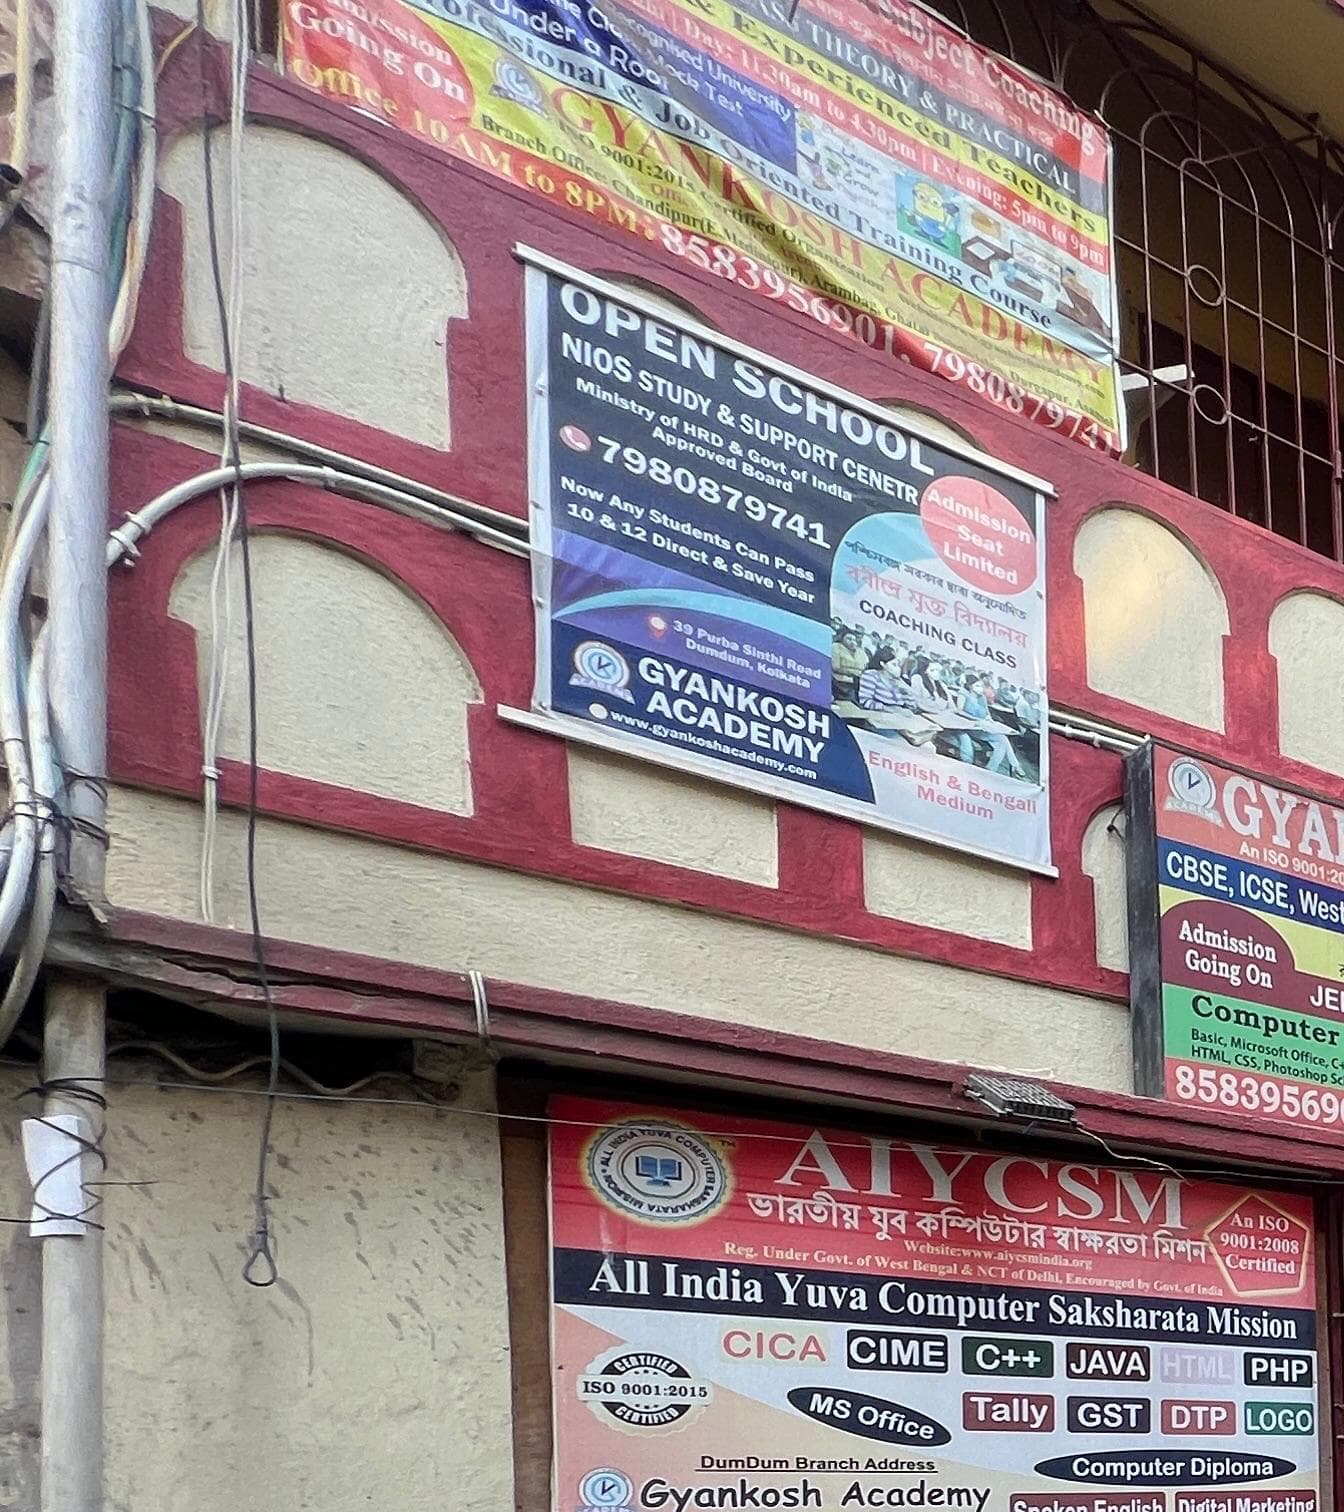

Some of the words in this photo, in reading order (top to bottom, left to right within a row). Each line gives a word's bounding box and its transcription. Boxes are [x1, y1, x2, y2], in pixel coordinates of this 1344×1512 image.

[292, 59, 400, 116] Office
[412, 110, 514, 178] 10AM
[732, 11, 953, 151] Experienced
[960, 138, 1099, 234] Teachers
[808, 20, 917, 98] THEORY
[946, 102, 1079, 194] PRACTICAL
[729, 136, 841, 222] Oriented
[967, 273, 1054, 329] Course
[561, 283, 715, 380] OPEN
[732, 359, 935, 475] SCHOOL
[562, 332, 631, 383] NIOS
[638, 370, 711, 416] STUDY
[717, 404, 735, 427] &
[740, 413, 838, 471] SUPPORT
[842, 458, 919, 506] CENETR
[576, 378, 655, 422] Ministry
[683, 421, 723, 447] HRD
[652, 427, 736, 470] Approved
[742, 464, 793, 493] Board
[597, 436, 831, 549] 7980879741
[649, 510, 730, 549] Students
[928, 489, 1031, 544] Admission
[958, 525, 1005, 556] Seat
[944, 542, 1019, 585] Limited
[860, 600, 956, 645] COACHING
[962, 638, 1017, 669] CLASS
[638, 657, 830, 739] GYANKOSH
[610, 710, 817, 780] www.gyankoshacademy.com
[647, 691, 825, 763] ACADEMY
[868, 750, 940, 784] English
[968, 781, 1037, 816] Bengali
[917, 785, 994, 820] Medium
[1167, 851, 1234, 898] CBSE,
[1239, 871, 1295, 915] ICSE,
[1178, 919, 1277, 963] Admission
[1185, 949, 1241, 986] Going
[1246, 964, 1273, 988] On
[1191, 993, 1340, 1046] Computer
[1231, 1036, 1288, 1060] Microsoft
[1264, 1060, 1328, 1085] Photoshop
[774, 1128, 1188, 1231] AIYCSM
[746, 1189, 862, 1231] ভারতীয়
[869, 1205, 907, 1242] যুব
[1152, 1229, 1209, 1265] মিশন
[1220, 1233, 1300, 1255] 9001:2008
[1066, 1273, 1135, 1292] Encouraged
[1225, 1255, 1296, 1276] Certified
[589, 1256, 651, 1297] All
[665, 1262, 764, 1304] India
[774, 1271, 869, 1312] Yuva
[877, 1280, 1040, 1328] Computer
[1048, 1293, 1200, 1335] Saksharata
[1207, 1306, 1297, 1340] Mission
[722, 1329, 828, 1363] CICA
[848, 1335, 946, 1368] CIME
[975, 1343, 1042, 1371] C++
[1069, 1349, 1147, 1377] JAVA
[1162, 1353, 1233, 1381] HTML
[621, 1381, 708, 1399] 9001:2015
[1250, 1357, 1309, 1383] PHP
[808, 1391, 851, 1420] MS
[857, 1405, 936, 1440] Office
[968, 1395, 1049, 1430] Tally
[1077, 1402, 1142, 1429] GST
[1170, 1404, 1228, 1430] DTP
[1246, 1407, 1312, 1432] LOGO
[700, 1455, 789, 1471] DumDum
[795, 1456, 860, 1471] Branch
[864, 1457, 935, 1472] Address
[1071, 1457, 1186, 1481] Computer
[1190, 1457, 1274, 1481] Diploma
